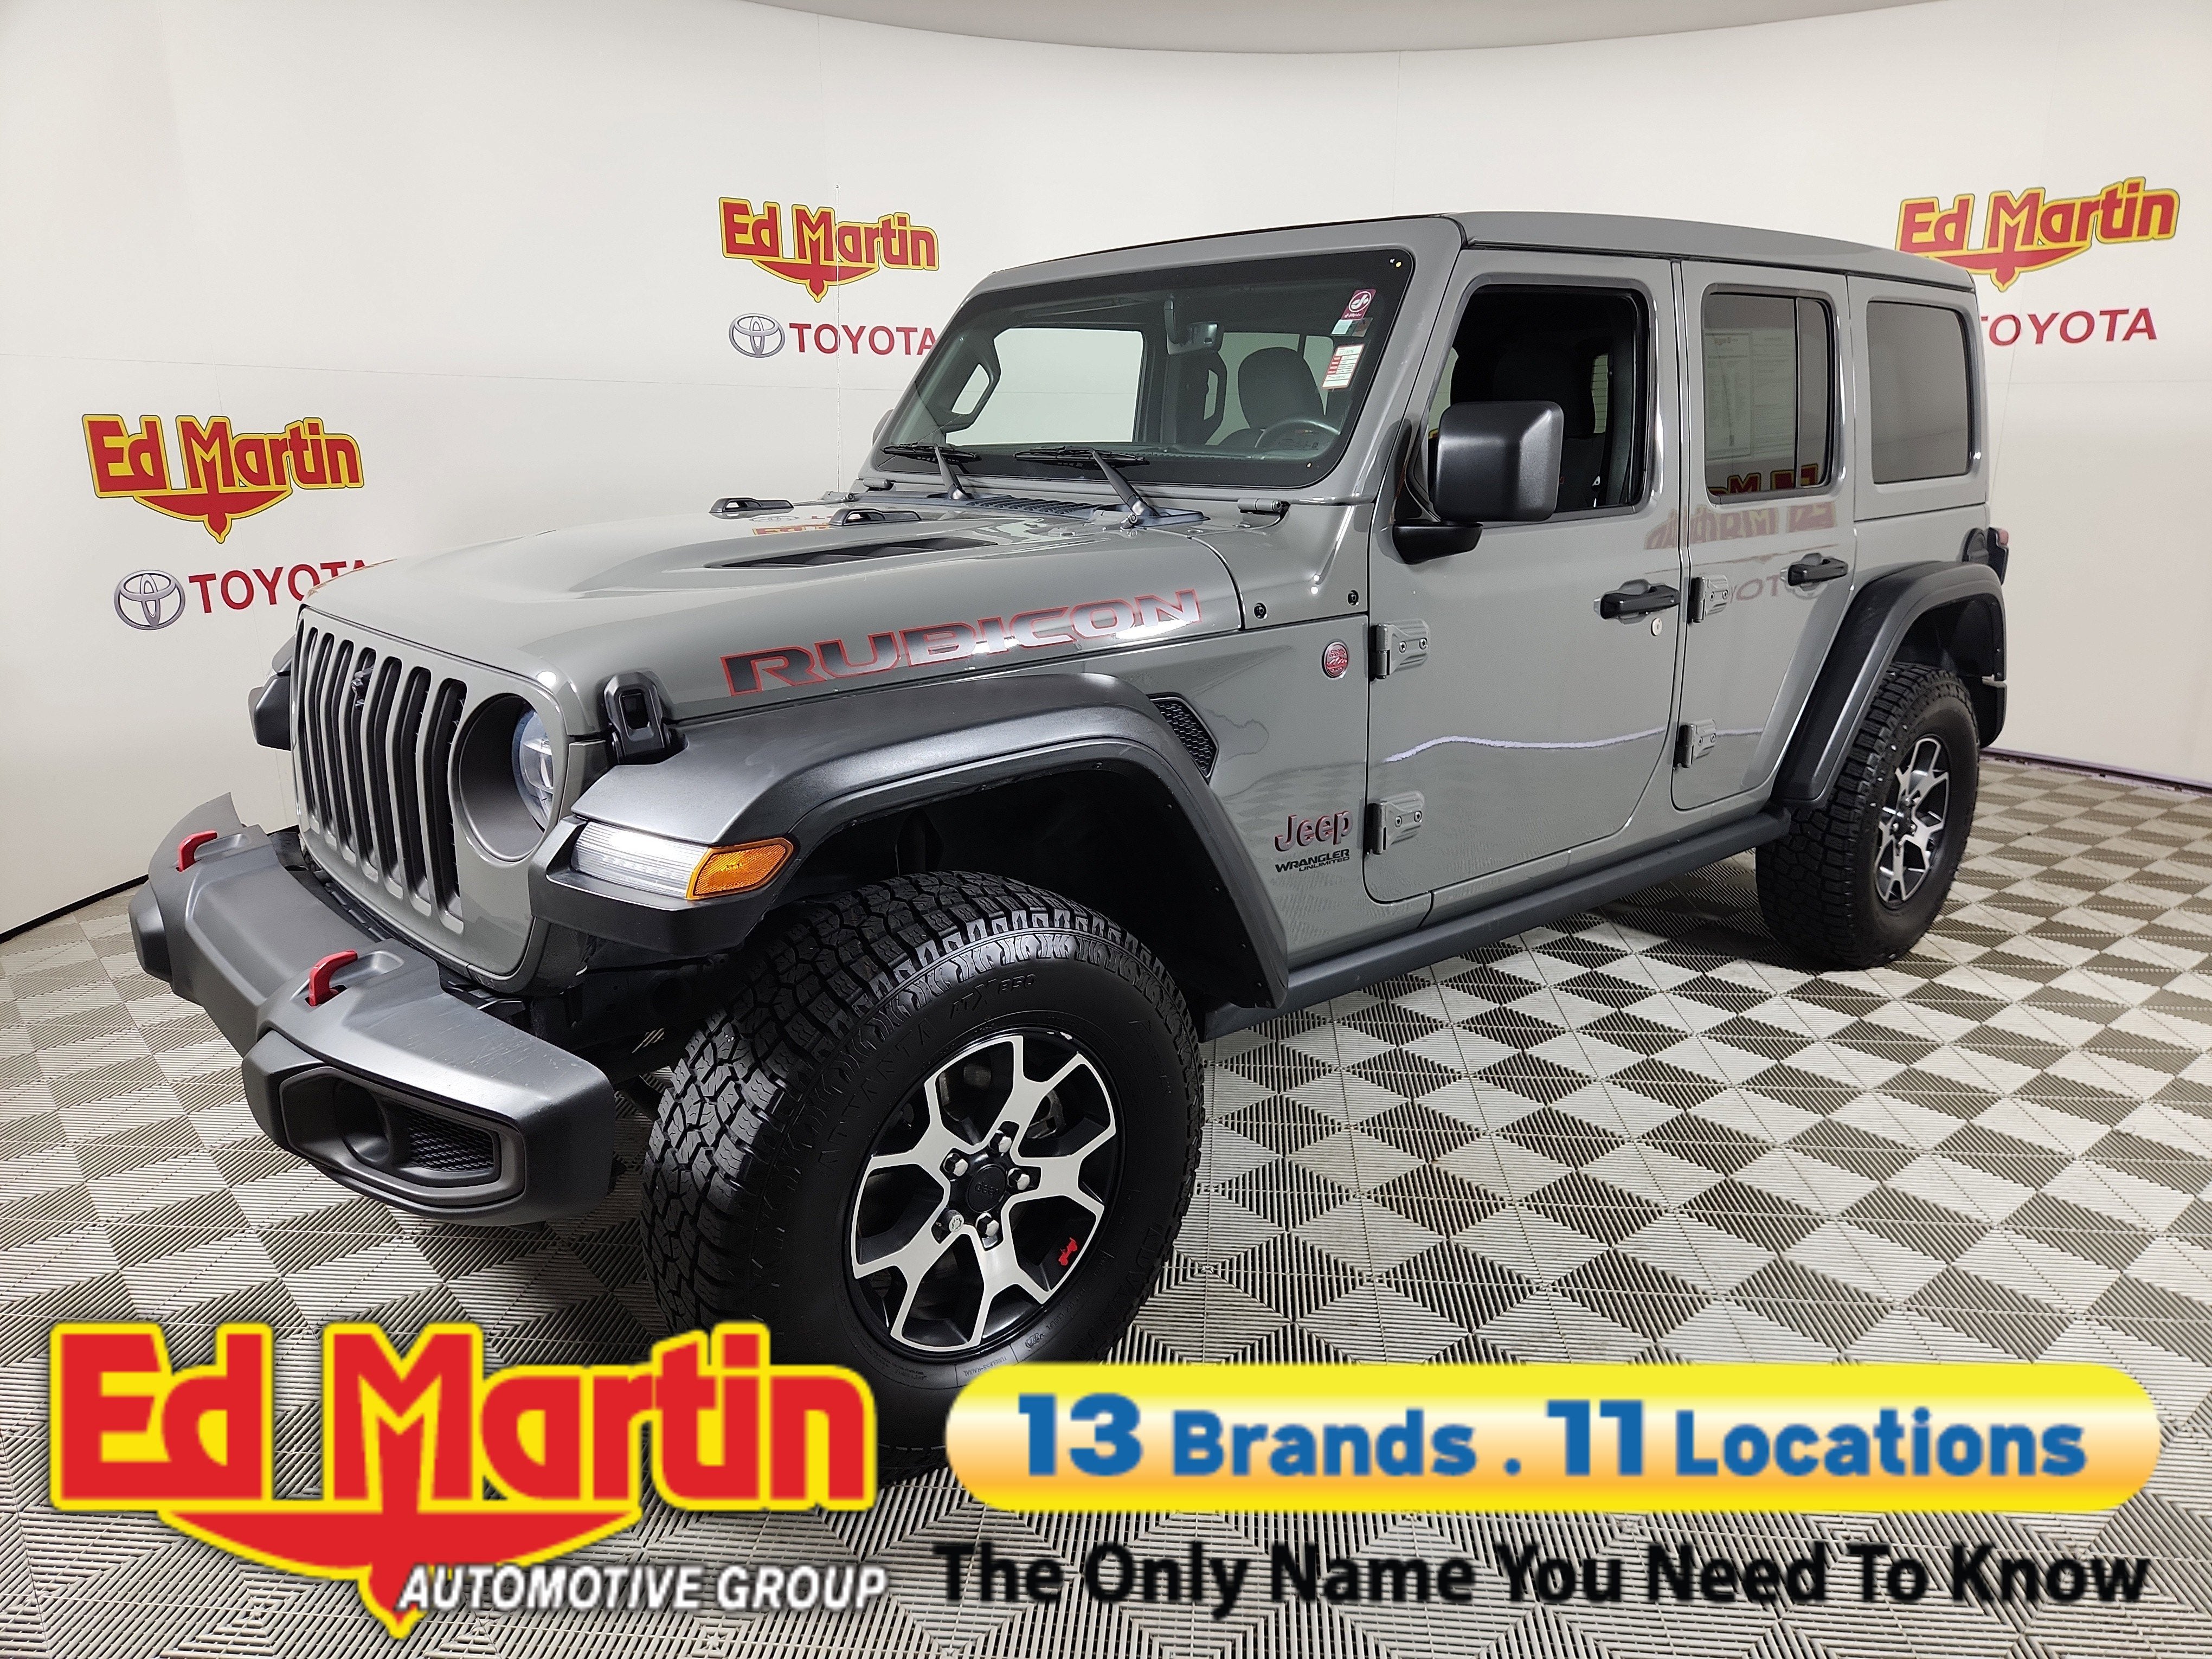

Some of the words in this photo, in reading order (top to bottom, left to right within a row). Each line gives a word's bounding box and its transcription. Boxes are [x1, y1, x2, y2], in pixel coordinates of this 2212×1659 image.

[719, 197, 781, 259] Ed
[792, 204, 940, 271] Martin
[1895, 194, 1975, 255] Ed
[1983, 176, 2180, 250] Martin
[789, 323, 937, 356] TOYOTA
[1982, 308, 2157, 345] OYOTA
[82, 414, 171, 498] Ed
[176, 414, 364, 488] Martin
[189, 560, 368, 614] TOYO
[721, 590, 1202, 696] RUBICON
[1275, 811, 1353, 851] Jeep
[1275, 848, 1349, 872] WRANGLER
[1298, 856, 1349, 872] UNLIMITED
